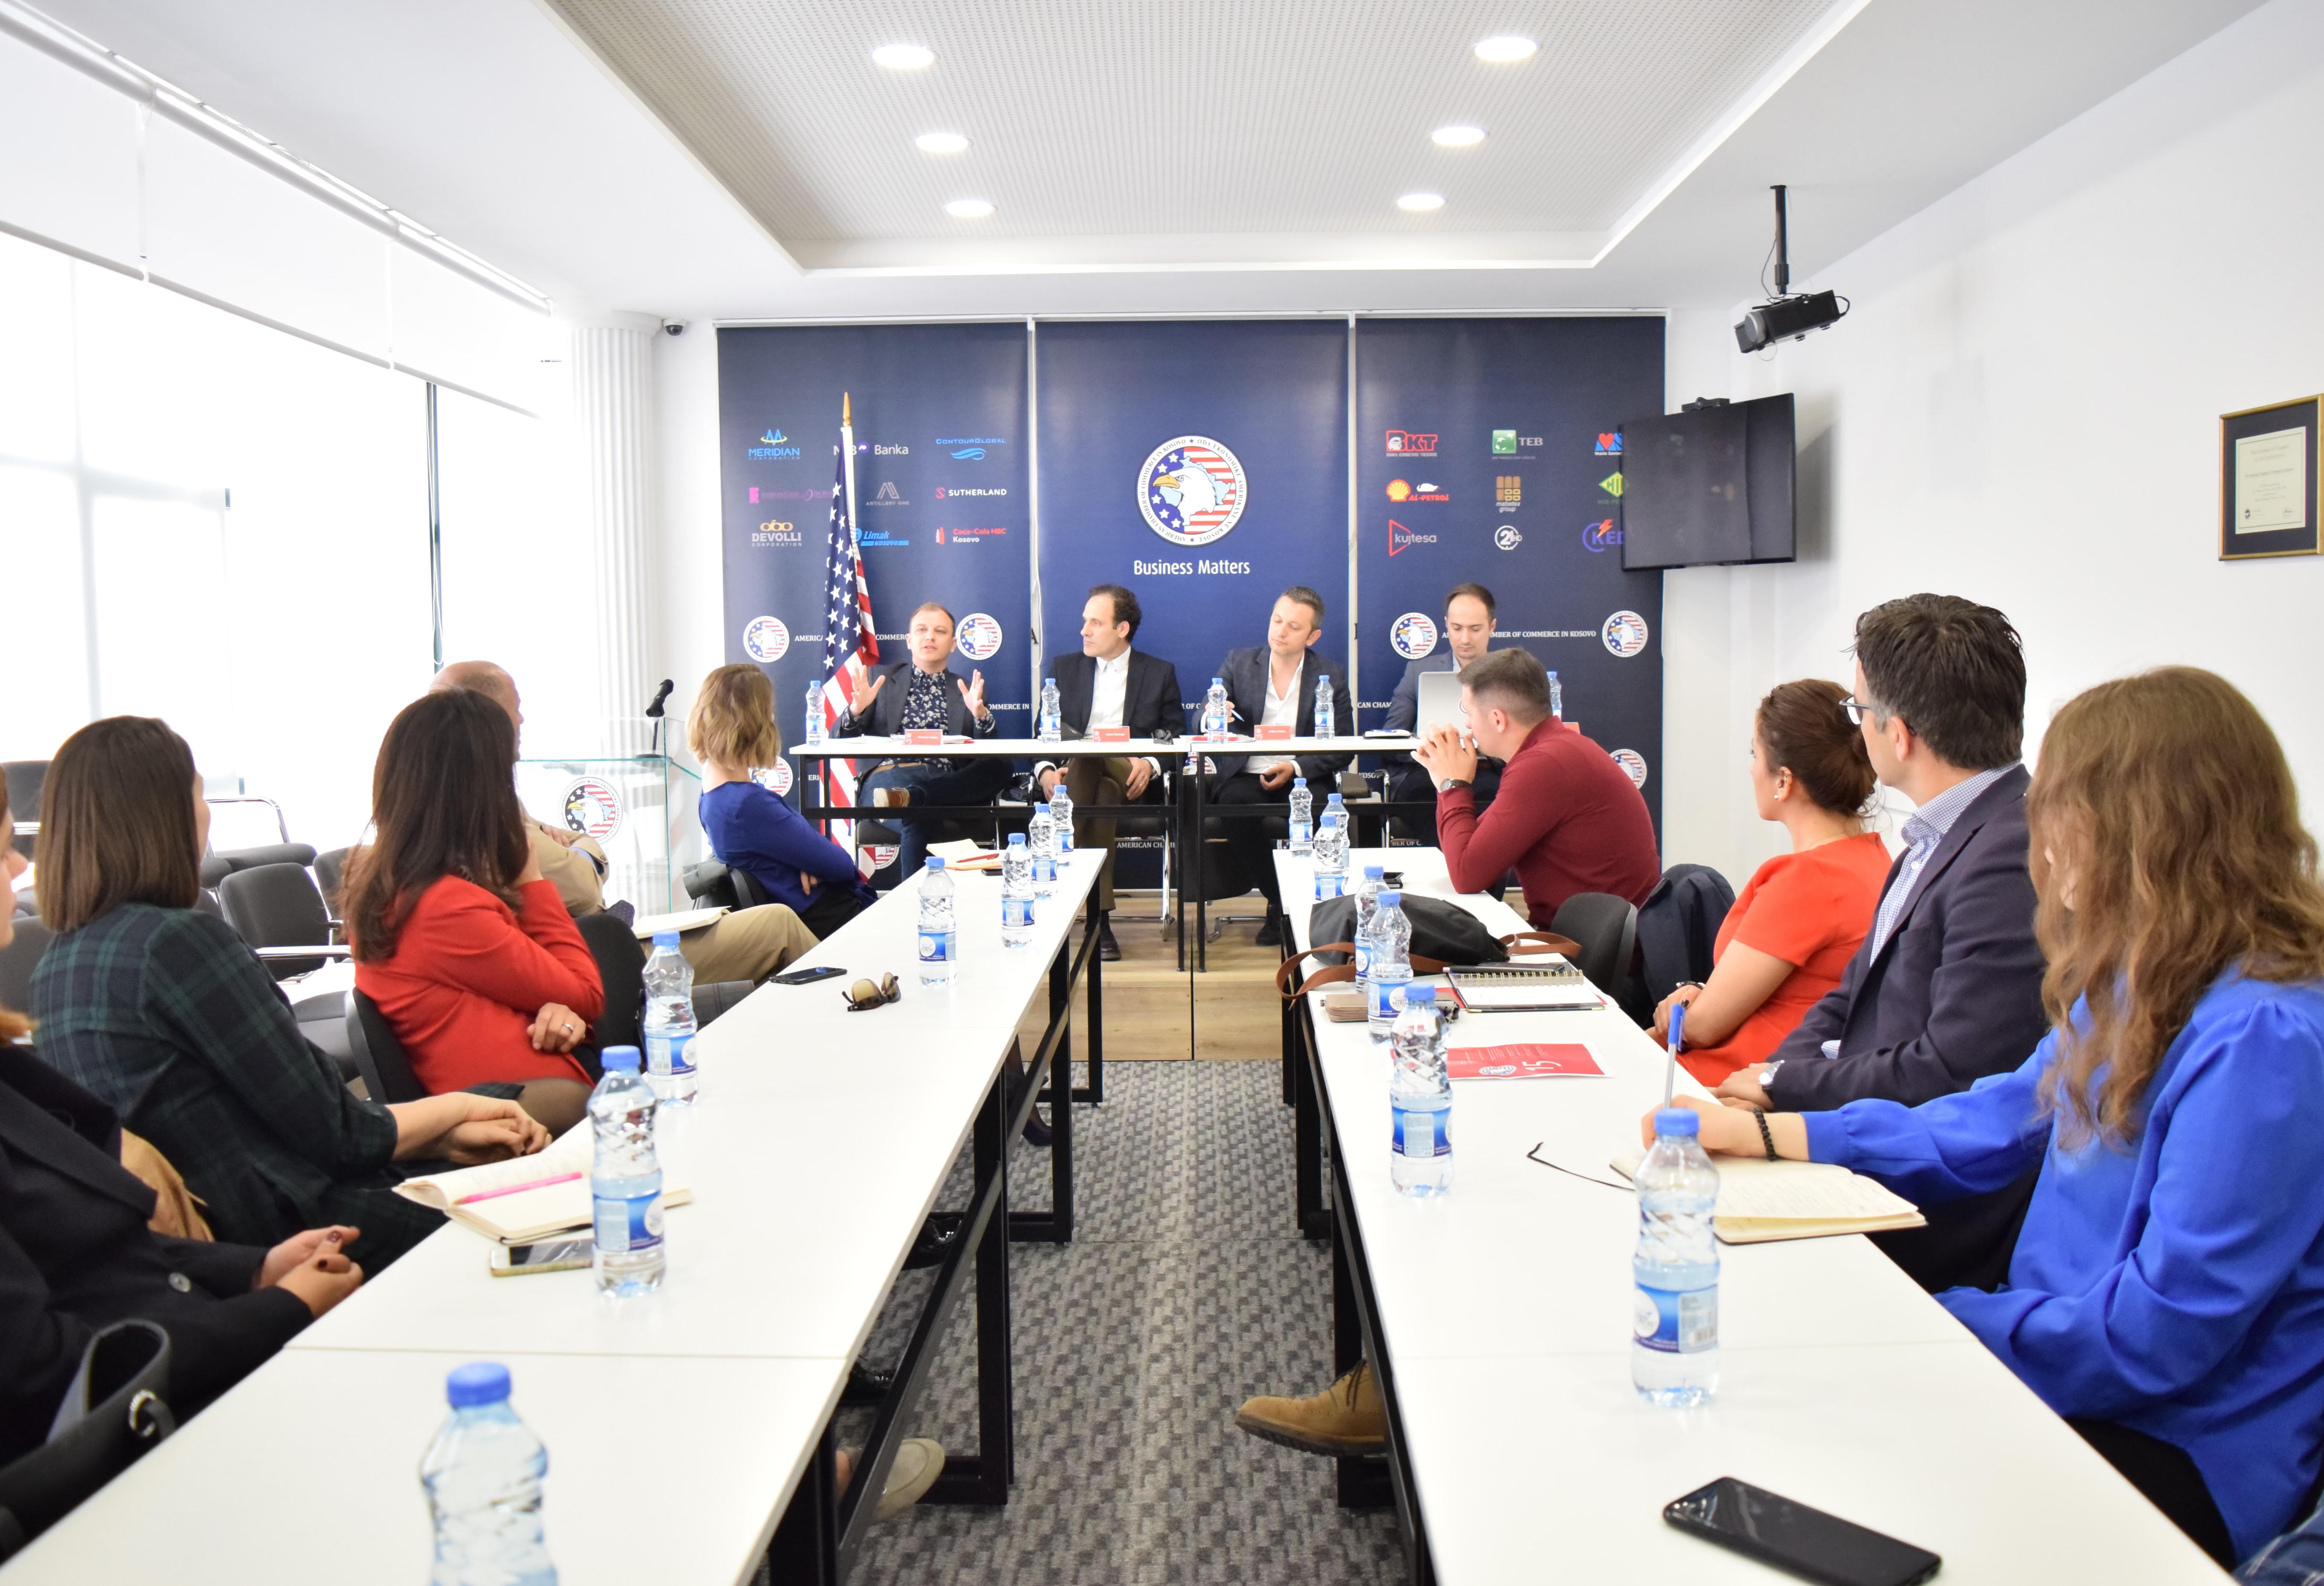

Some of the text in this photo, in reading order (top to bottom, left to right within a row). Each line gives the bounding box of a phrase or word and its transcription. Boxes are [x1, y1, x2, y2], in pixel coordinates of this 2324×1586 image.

[1163, 439, 1186, 452] KOSOVO
[1386, 430, 1438, 452] BKT
[1518, 438, 1543, 446] TEB
[749, 448, 800, 457] MERIDIAN
[874, 444, 908, 455] Banka
[752, 532, 802, 542] DEVOLLI
[863, 531, 890, 539] Limak
[1395, 533, 1437, 545] kujtesa
[1134, 559, 1250, 575] Business Matters
